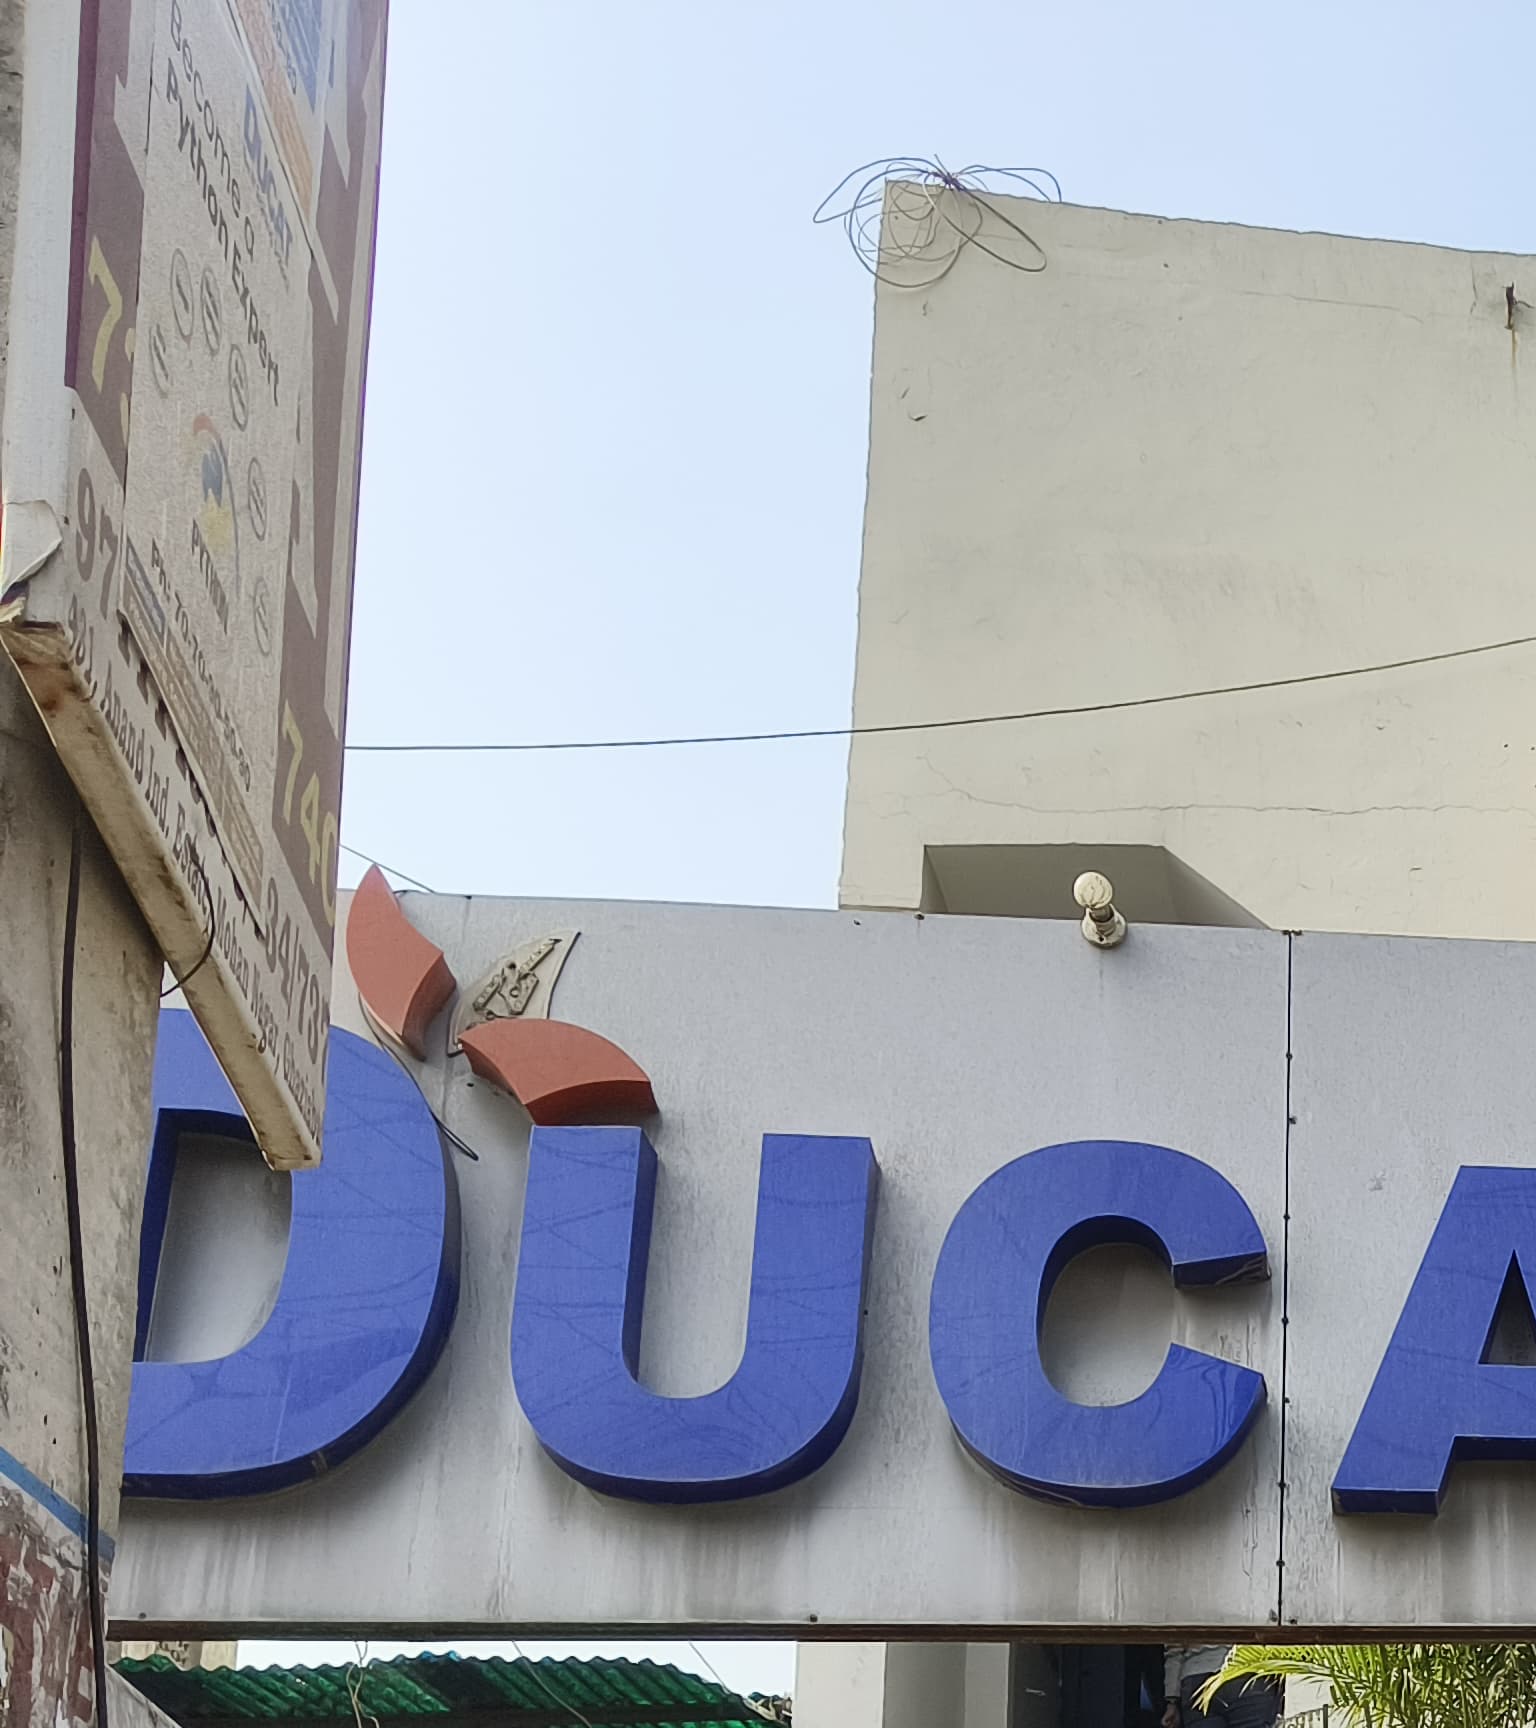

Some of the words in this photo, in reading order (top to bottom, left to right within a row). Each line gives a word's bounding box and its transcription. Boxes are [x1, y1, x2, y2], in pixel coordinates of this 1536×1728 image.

[166, 57, 229, 262] Python
[231, 239, 279, 407] Expert
[244, 83, 293, 268] DUCAT
[100, 660, 145, 785] Anand
[216, 886, 249, 997] Mohan
